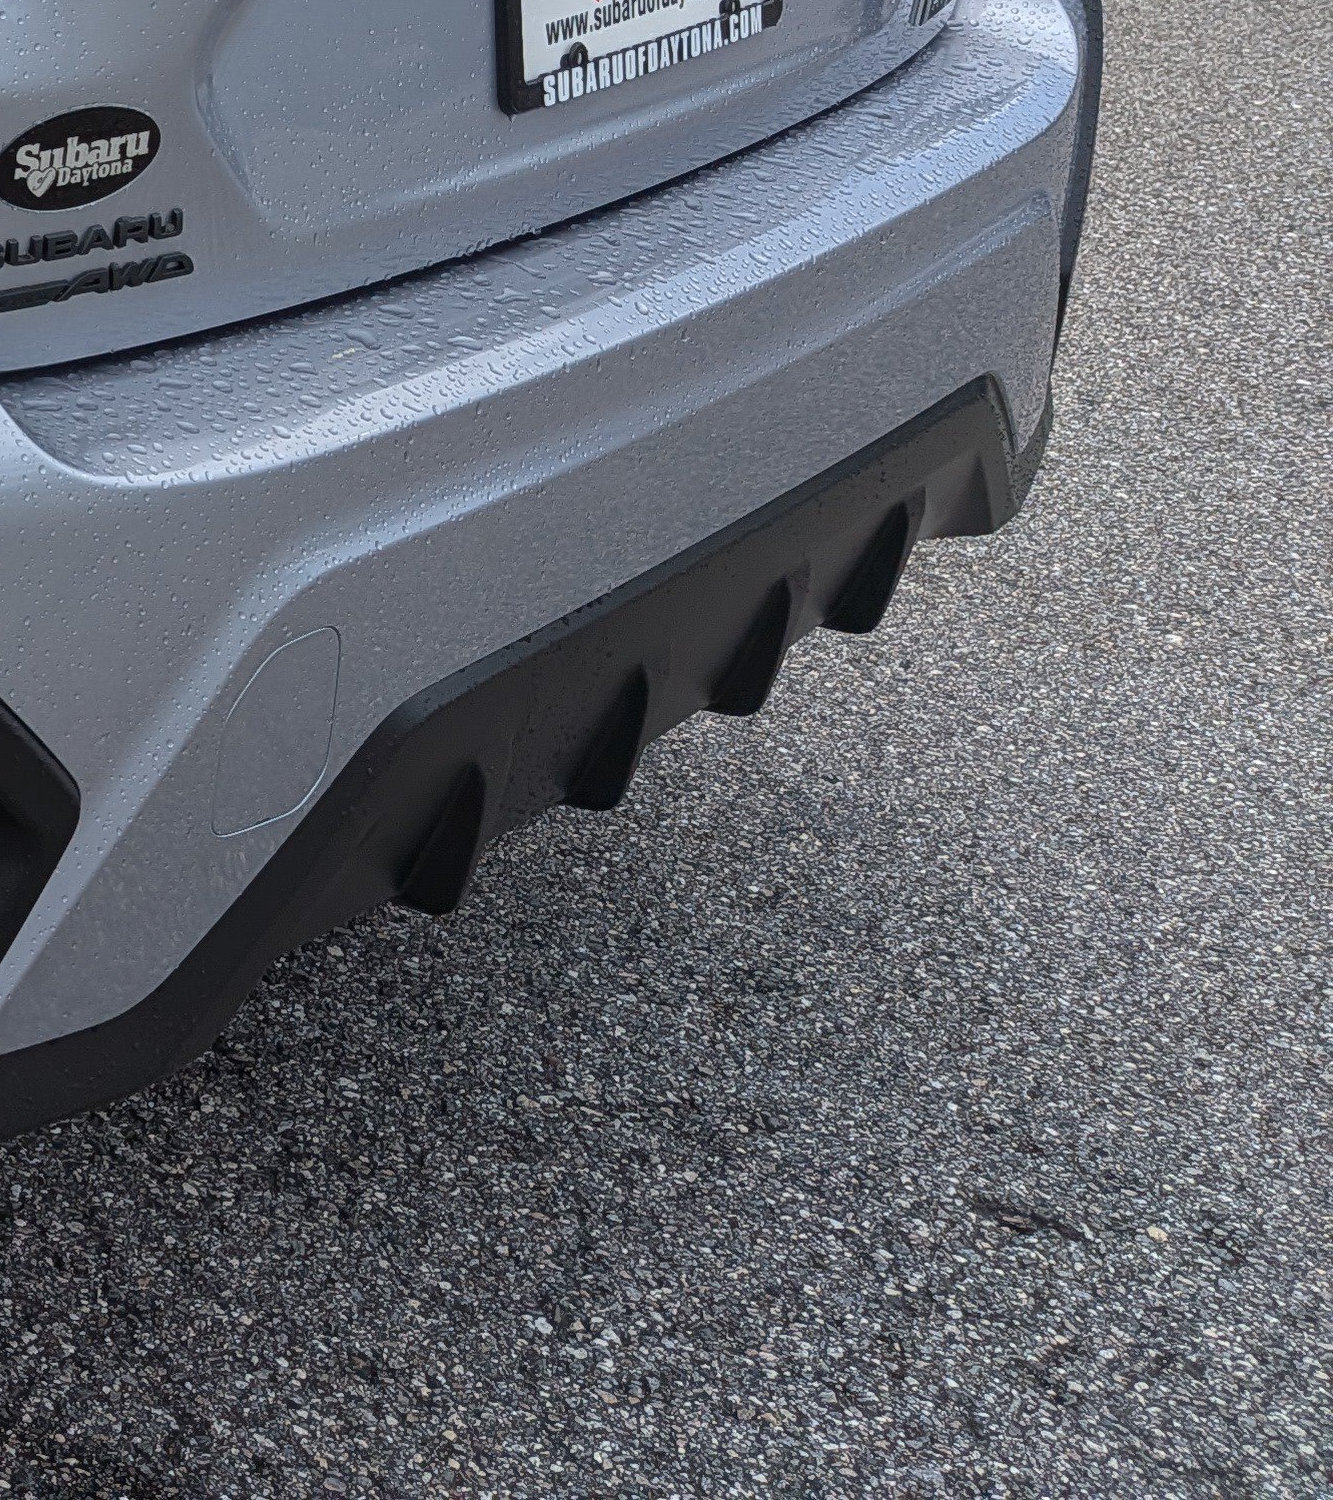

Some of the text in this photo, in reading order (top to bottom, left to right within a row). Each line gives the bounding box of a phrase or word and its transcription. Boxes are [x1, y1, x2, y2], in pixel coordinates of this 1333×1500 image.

[542, 4, 763, 107] SUBARUOFDAYTONA.COM
[14, 130, 151, 180] Subaru
[56, 157, 134, 187] Daytona
[52, 250, 195, 302] AWD
